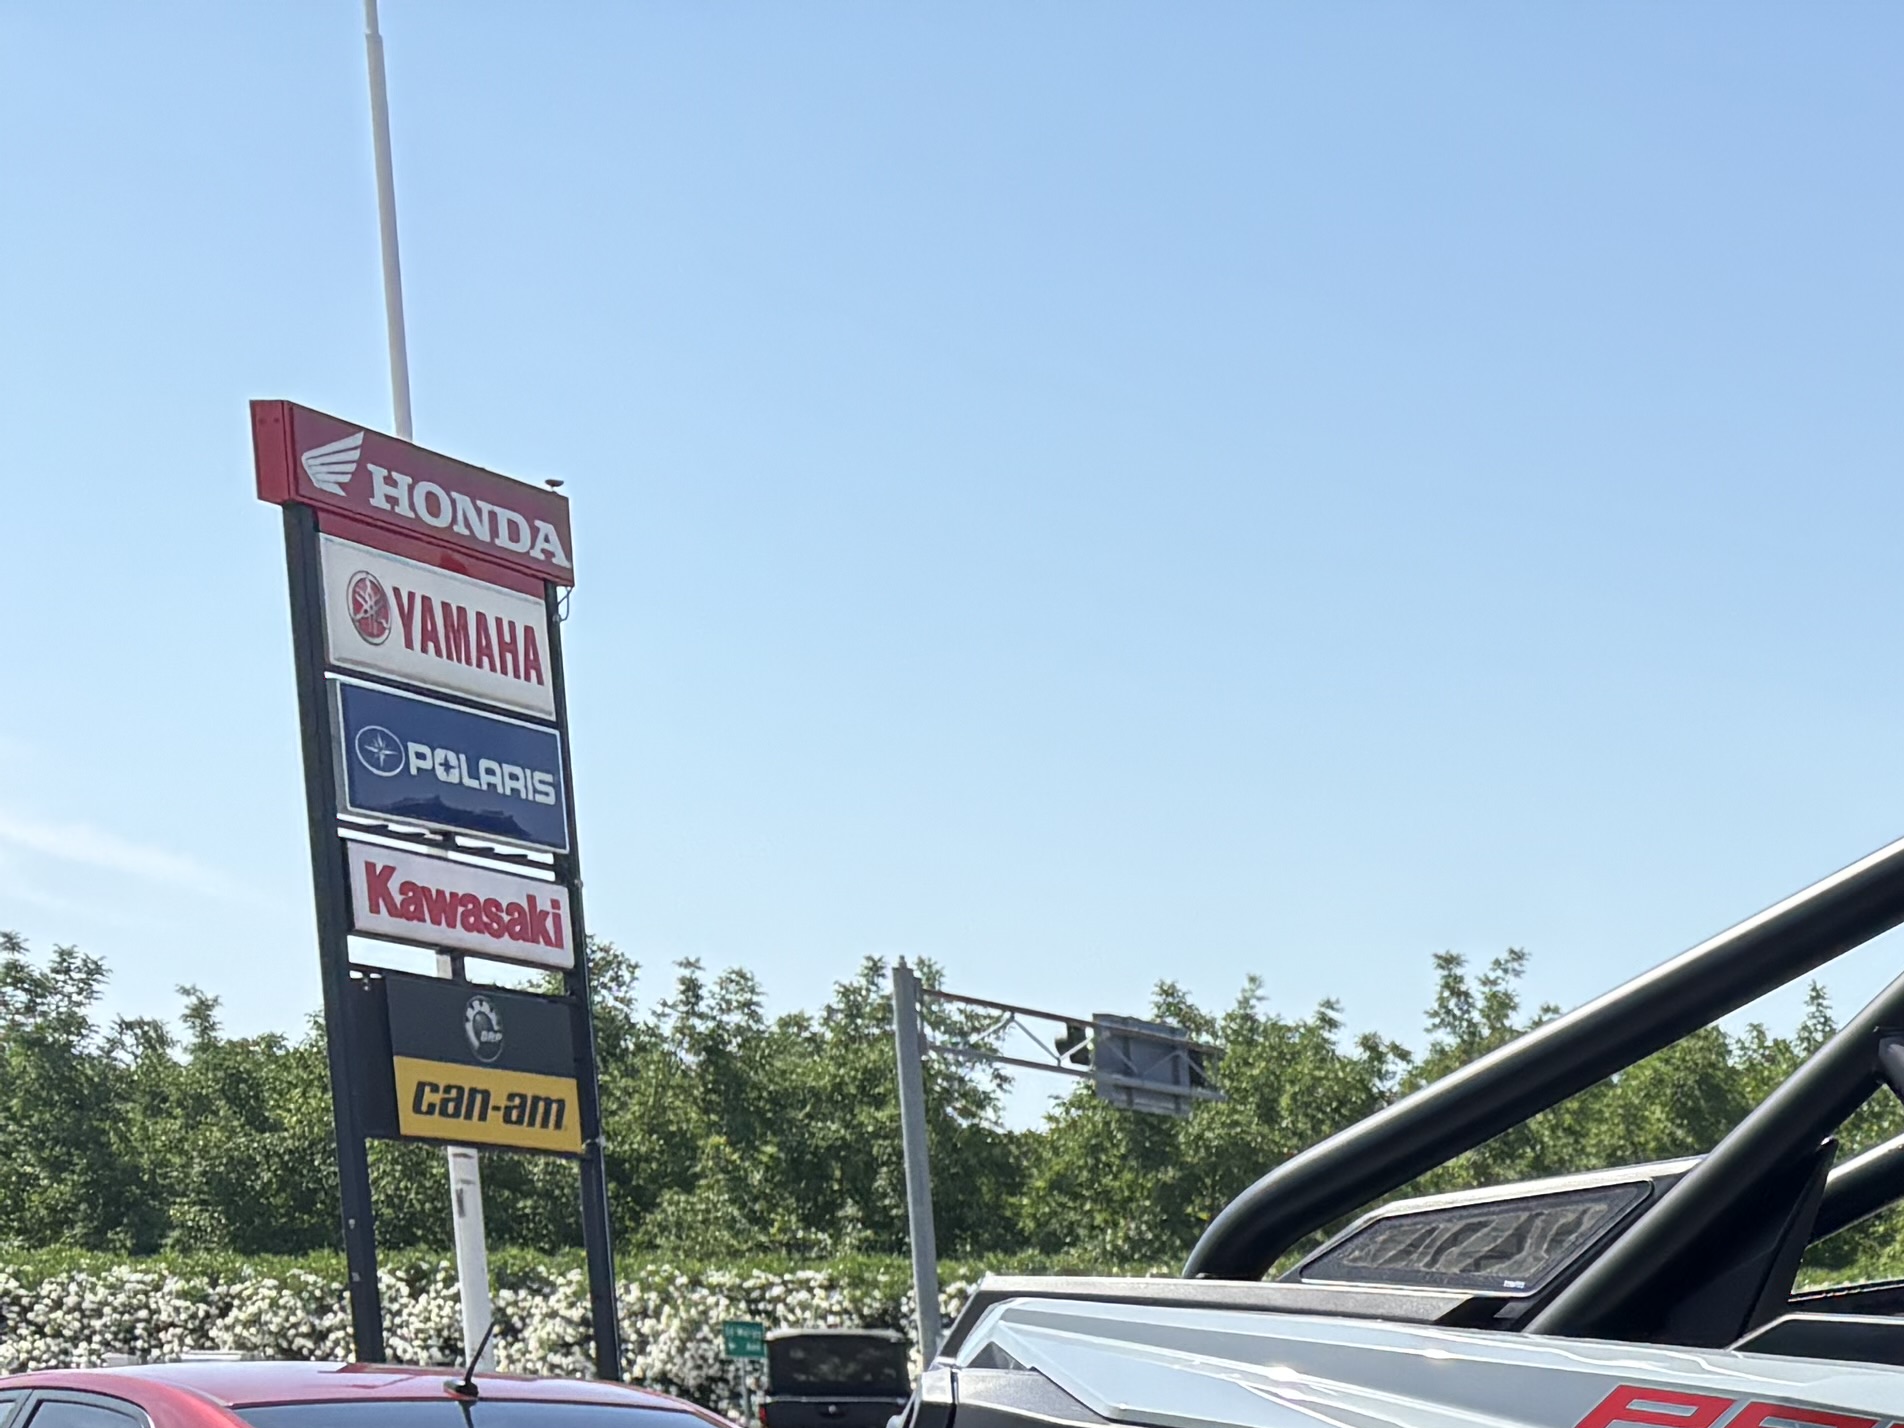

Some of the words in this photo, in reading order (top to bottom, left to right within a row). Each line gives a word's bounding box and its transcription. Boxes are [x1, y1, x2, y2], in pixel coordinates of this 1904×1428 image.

[366, 463, 571, 568] HONDA
[393, 586, 545, 686] YAMAHA
[407, 742, 556, 805] POLARIS
[364, 860, 565, 950] Kawasaki
[412, 1080, 566, 1130] can-am
